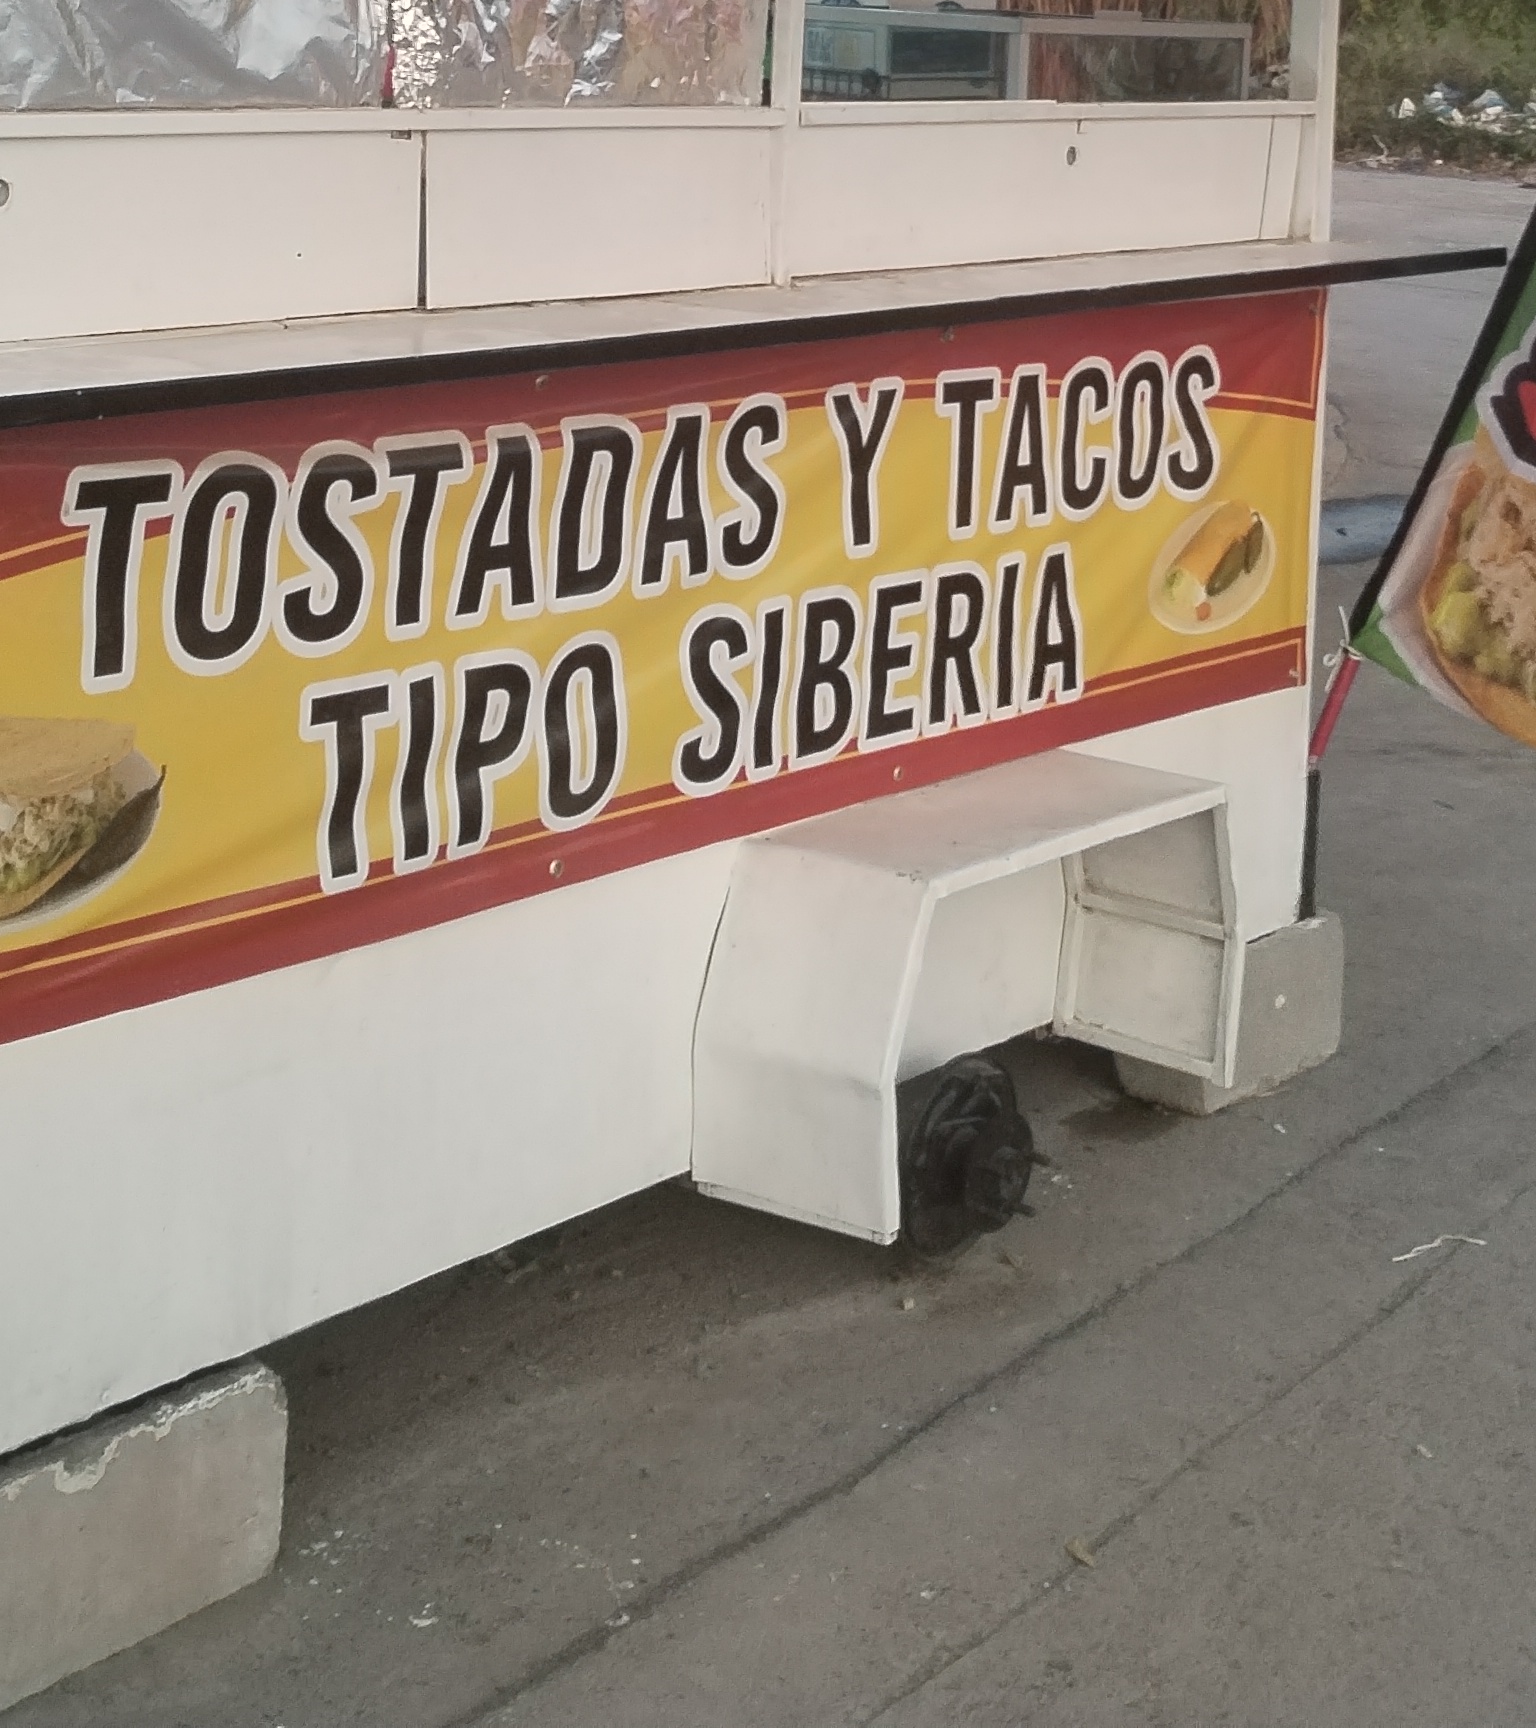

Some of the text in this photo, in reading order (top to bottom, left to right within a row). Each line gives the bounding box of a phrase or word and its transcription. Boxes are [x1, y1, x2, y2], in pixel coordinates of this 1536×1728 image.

[66, 349, 1219, 685] TOSTADAS Y TACOS
[304, 547, 1081, 887] TIPO SIBERIA
